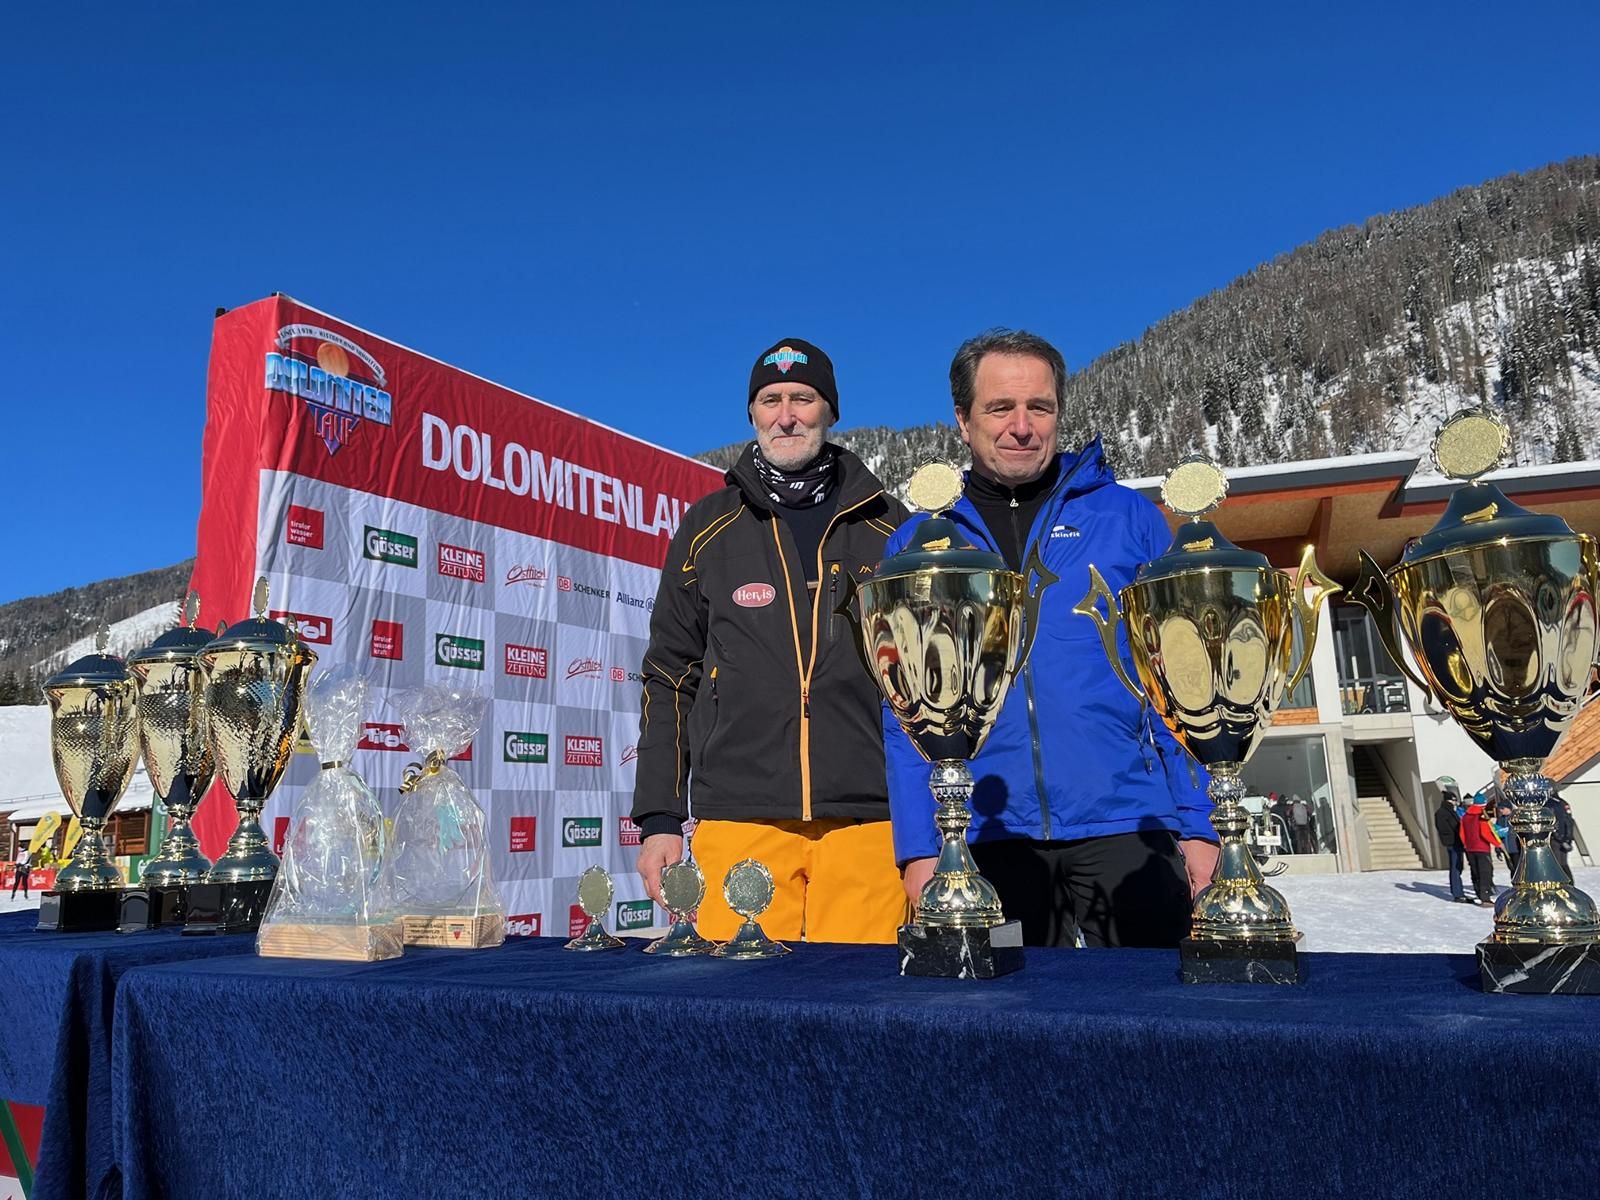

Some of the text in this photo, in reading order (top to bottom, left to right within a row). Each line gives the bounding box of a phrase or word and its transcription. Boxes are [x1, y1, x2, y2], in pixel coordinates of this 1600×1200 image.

[314, 408, 353, 447] LAUF
[422, 411, 693, 540] DOLOMITENLAU
[290, 528, 314, 538] wasser
[290, 533, 306, 543] kraft
[366, 529, 416, 560] Gösser
[440, 546, 483, 569] KLEINE
[440, 562, 484, 581] ZEITUNG
[558, 577, 570, 590] DB
[573, 582, 610, 599] SCHENKER
[737, 588, 772, 602] Hervis
[616, 591, 645, 609] Allianz
[438, 637, 482, 663] Gösser
[507, 647, 545, 665] KLEINE
[507, 663, 546, 678] ZEITUNG
[611, 669, 623, 680] DB
[506, 734, 547, 759] Gösser
[566, 738, 601, 752] KLEINE
[566, 753, 602, 765] ZEITUNG
[564, 820, 600, 845] Gösser
[618, 903, 652, 928] Gösser
